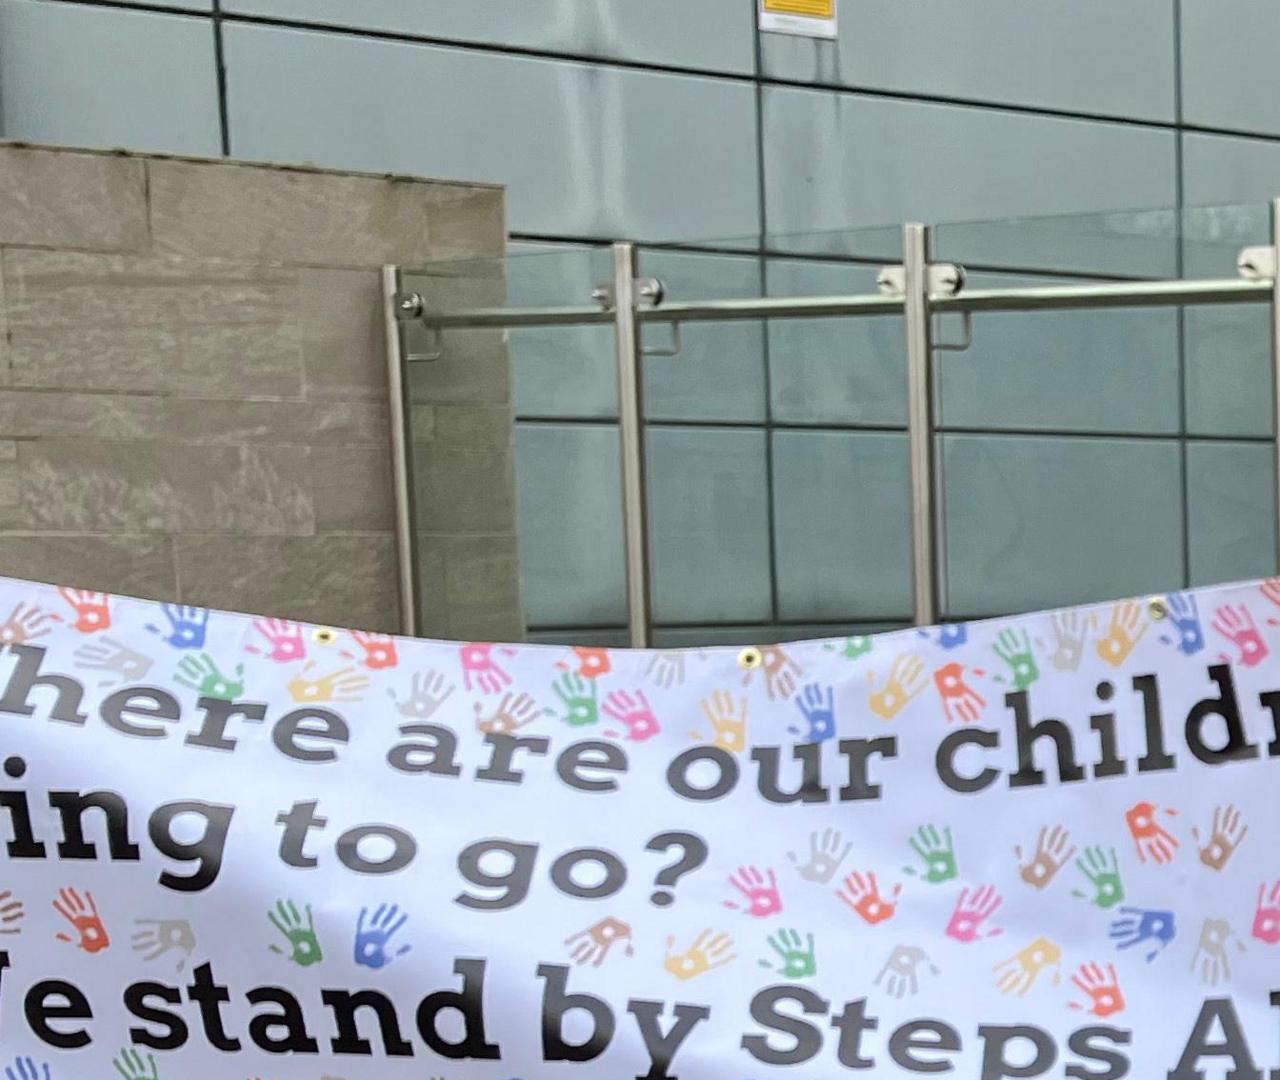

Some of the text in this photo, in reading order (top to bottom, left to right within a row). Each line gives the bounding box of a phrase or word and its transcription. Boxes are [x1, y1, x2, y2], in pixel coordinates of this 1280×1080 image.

[0, 640, 351, 767] here
[385, 724, 630, 794] are
[664, 731, 898, 805] our
[274, 801, 418, 877] to
[453, 830, 710, 912] go?
[0, 949, 95, 1050] e
[123, 957, 501, 1062] stand
